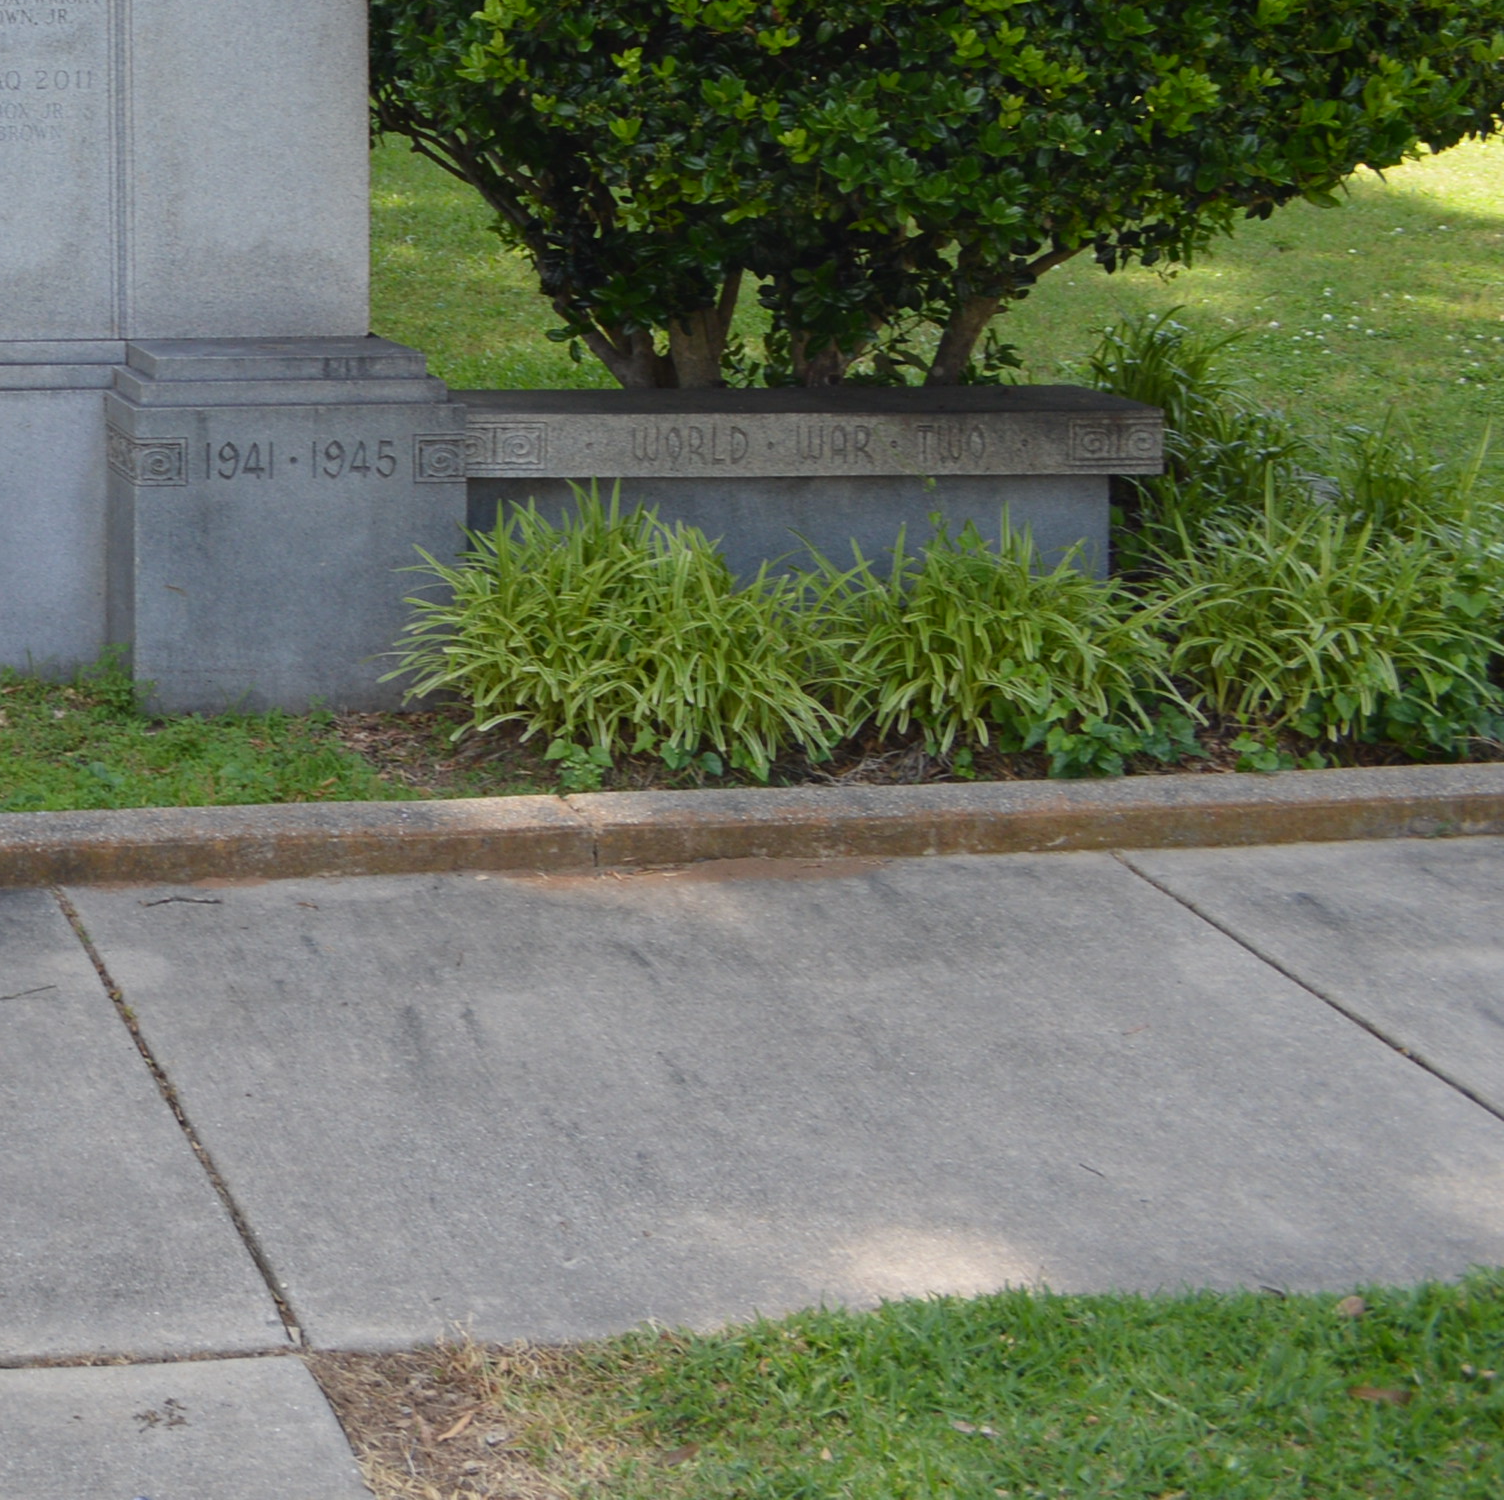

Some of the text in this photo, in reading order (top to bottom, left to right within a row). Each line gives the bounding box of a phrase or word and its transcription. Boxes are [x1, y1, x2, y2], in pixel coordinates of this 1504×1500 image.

[35, 70, 92, 90] 2011
[206, 440, 397, 480] 1941 1945
[632, 424, 986, 463] WORLD WAR TWO
